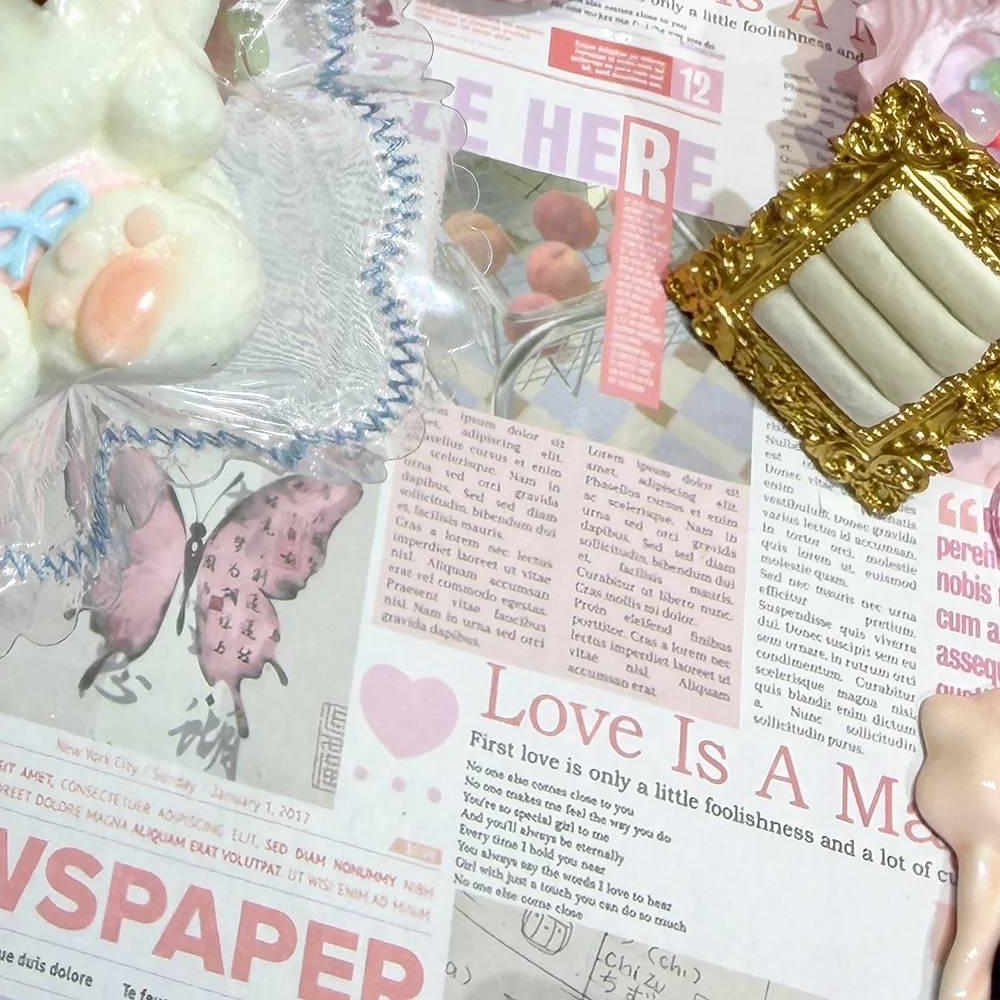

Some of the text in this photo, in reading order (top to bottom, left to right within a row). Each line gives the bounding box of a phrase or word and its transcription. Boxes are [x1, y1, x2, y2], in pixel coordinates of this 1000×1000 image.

[689, 8, 699, 18] a
[703, 9, 738, 30] little
[743, 20, 833, 53] foolishness
[679, 67, 711, 105] 12
[521, 98, 717, 217] HERE
[937, 570, 992, 604] nobis
[936, 607, 981, 638] cum
[481, 662, 644, 761] Love
[671, 714, 728, 785] Is
[755, 745, 809, 810] A
[469, 730, 514, 759] First
[521, 744, 559, 769] love
[566, 757, 582, 776] is
[589, 768, 632, 793] only
[637, 782, 649, 796] a
[655, 782, 699, 810] little
[705, 796, 814, 844] foolishness
[820, 833, 856, 857] and
[862, 845, 874, 862] a
[880, 847, 906, 872] lot
[912, 860, 933, 879] of
[50, 962, 94, 988] dolore
